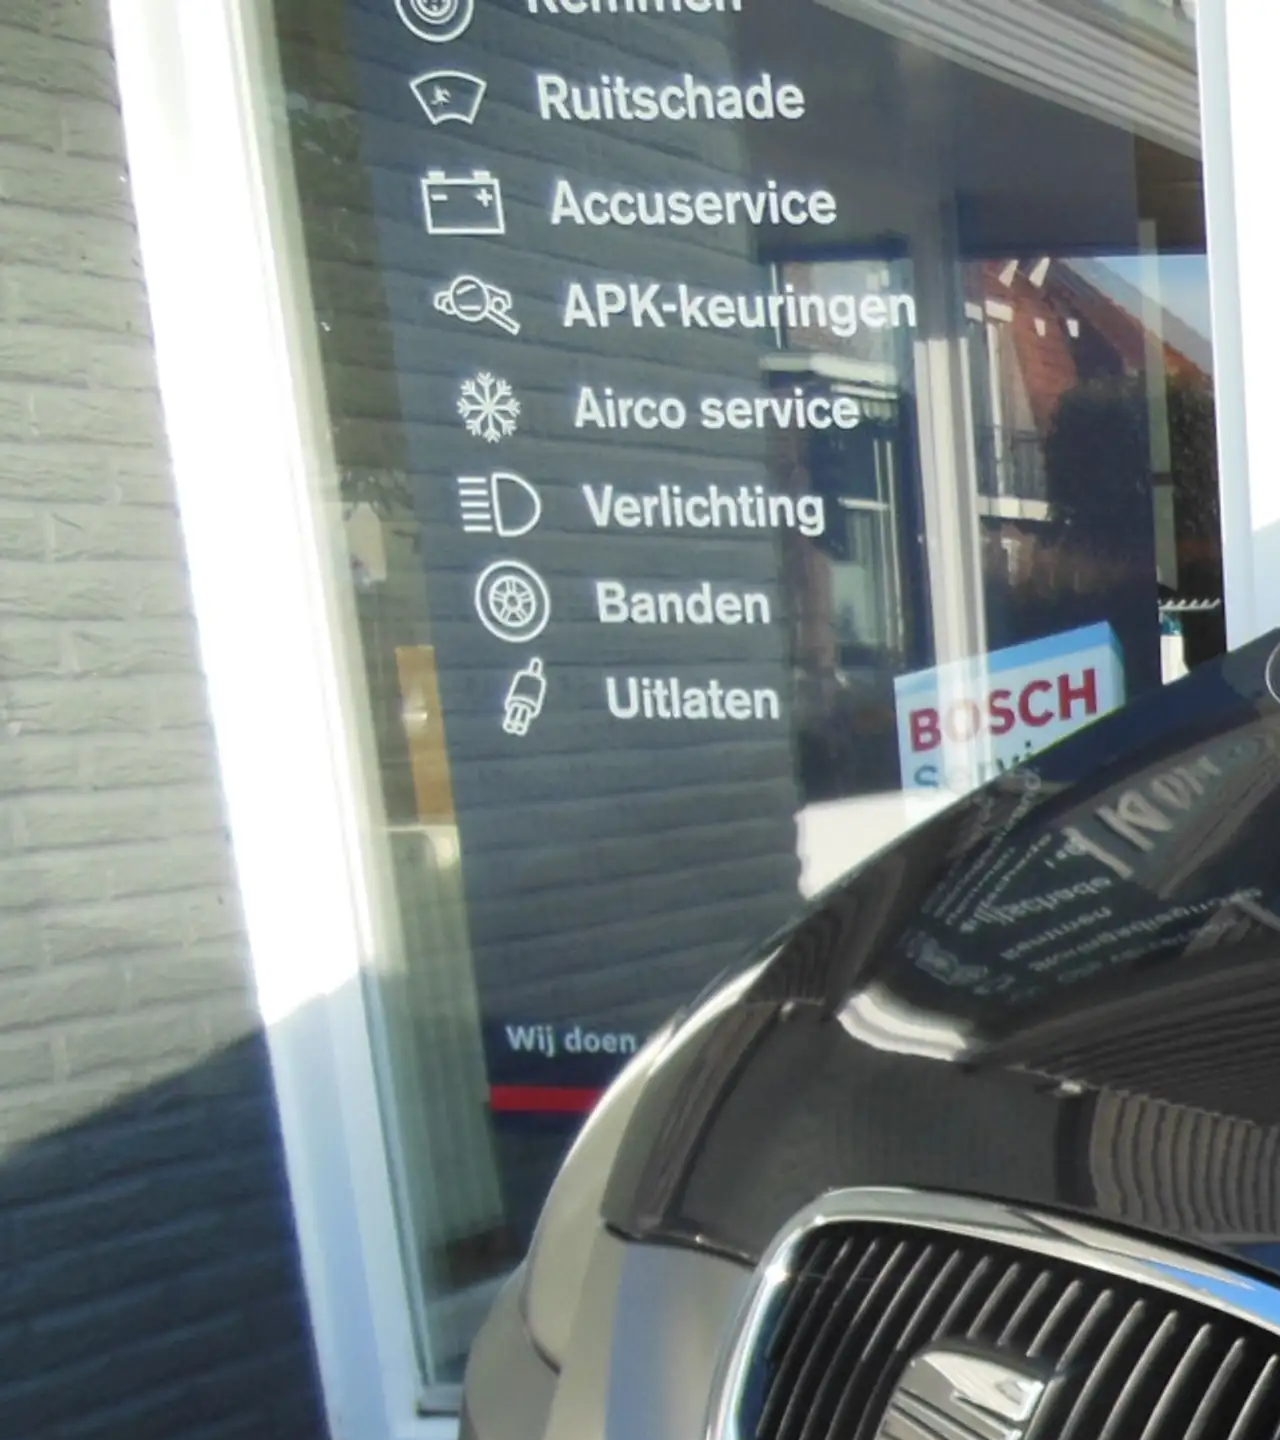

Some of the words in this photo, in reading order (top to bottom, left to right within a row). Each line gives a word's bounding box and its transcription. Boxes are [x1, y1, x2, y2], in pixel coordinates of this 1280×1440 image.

[537, 72, 805, 121] Ruitschade
[550, 180, 837, 226] Accuservice
[562, 283, 917, 336] APK-keuringen
[574, 386, 686, 429] Airco
[701, 386, 861, 429] service
[582, 484, 826, 537] Verlichting
[596, 580, 771, 625] Banden
[605, 676, 780, 720] Uitlaten
[909, 668, 1098, 752] BOSCH
[504, 1024, 555, 1058] Wij
[564, 1024, 637, 1053] doen
